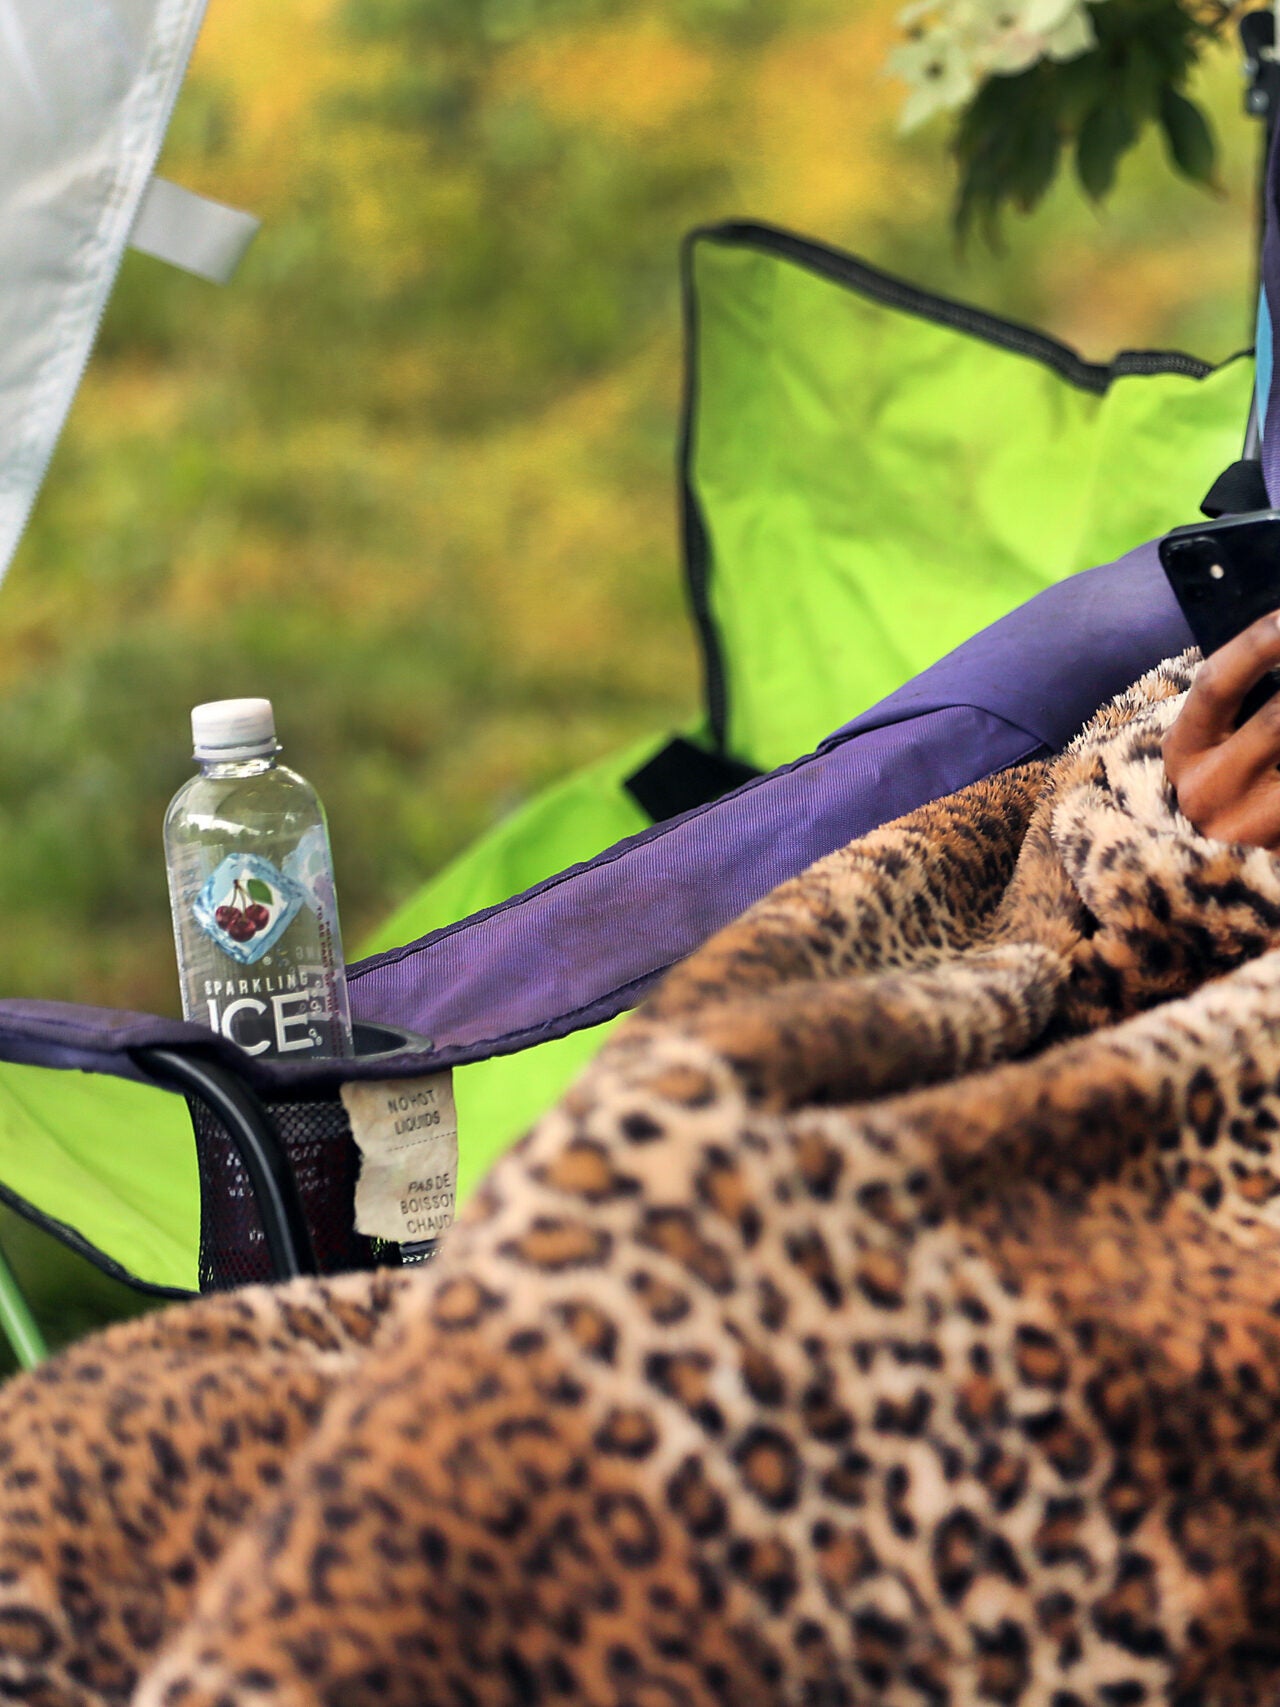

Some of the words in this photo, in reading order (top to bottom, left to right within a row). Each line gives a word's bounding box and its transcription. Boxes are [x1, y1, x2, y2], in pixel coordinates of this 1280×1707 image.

[204, 971, 308, 996] SPARKLING
[206, 990, 314, 1056] ICE
[387, 1096, 409, 1114] NO
[410, 1089, 435, 1108] HOT
[394, 1110, 440, 1135] LIQUIDS
[408, 1178, 433, 1194] PAS
[435, 1172, 451, 1190] DE
